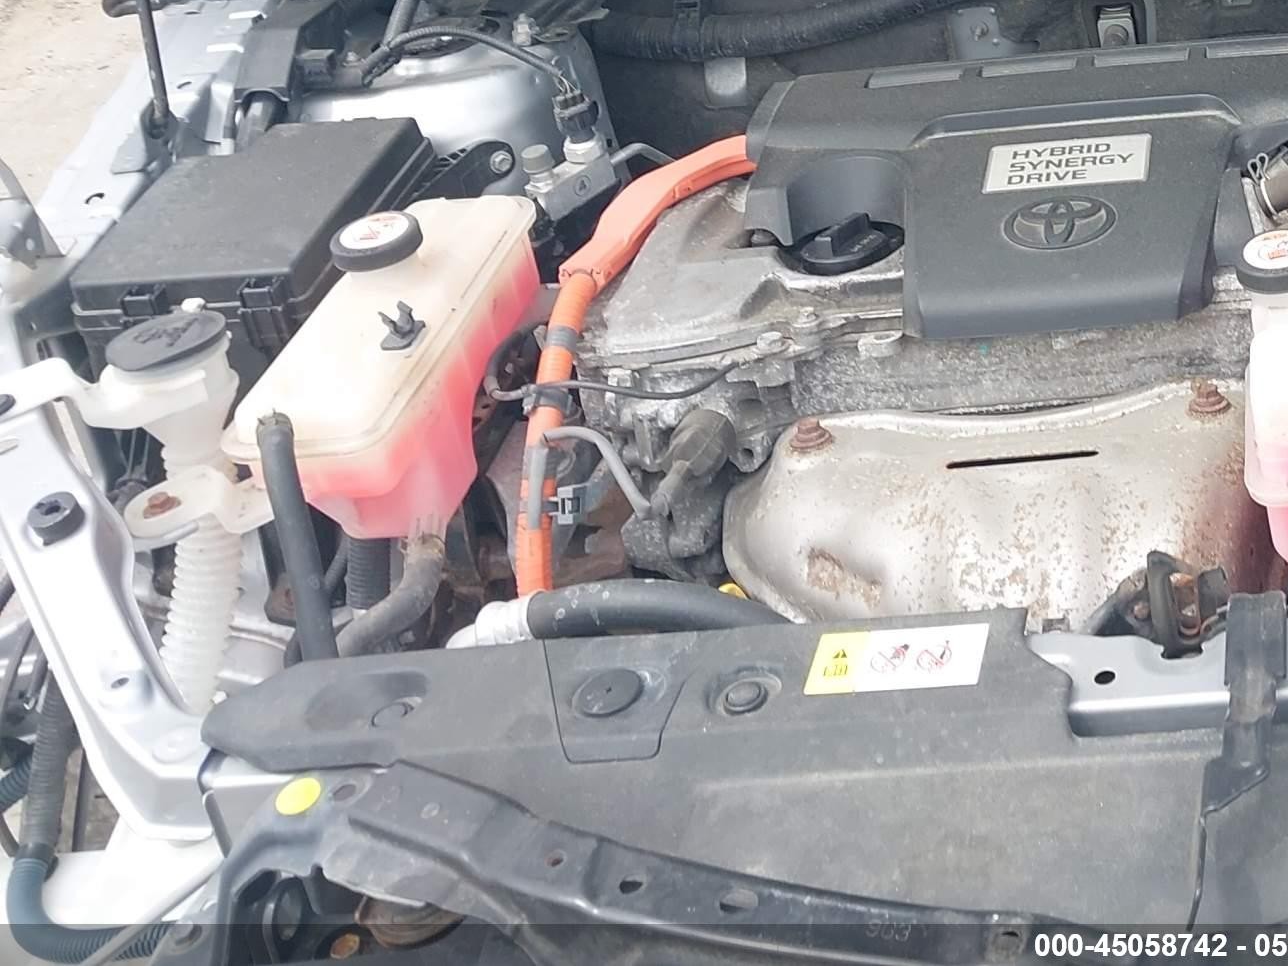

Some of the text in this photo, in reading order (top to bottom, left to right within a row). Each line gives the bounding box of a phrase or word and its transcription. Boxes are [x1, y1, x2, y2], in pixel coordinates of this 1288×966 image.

[1012, 142, 1111, 160] HYBRID
[1008, 152, 1134, 173] SYNERGY
[1007, 169, 1088, 185] DRIVE
